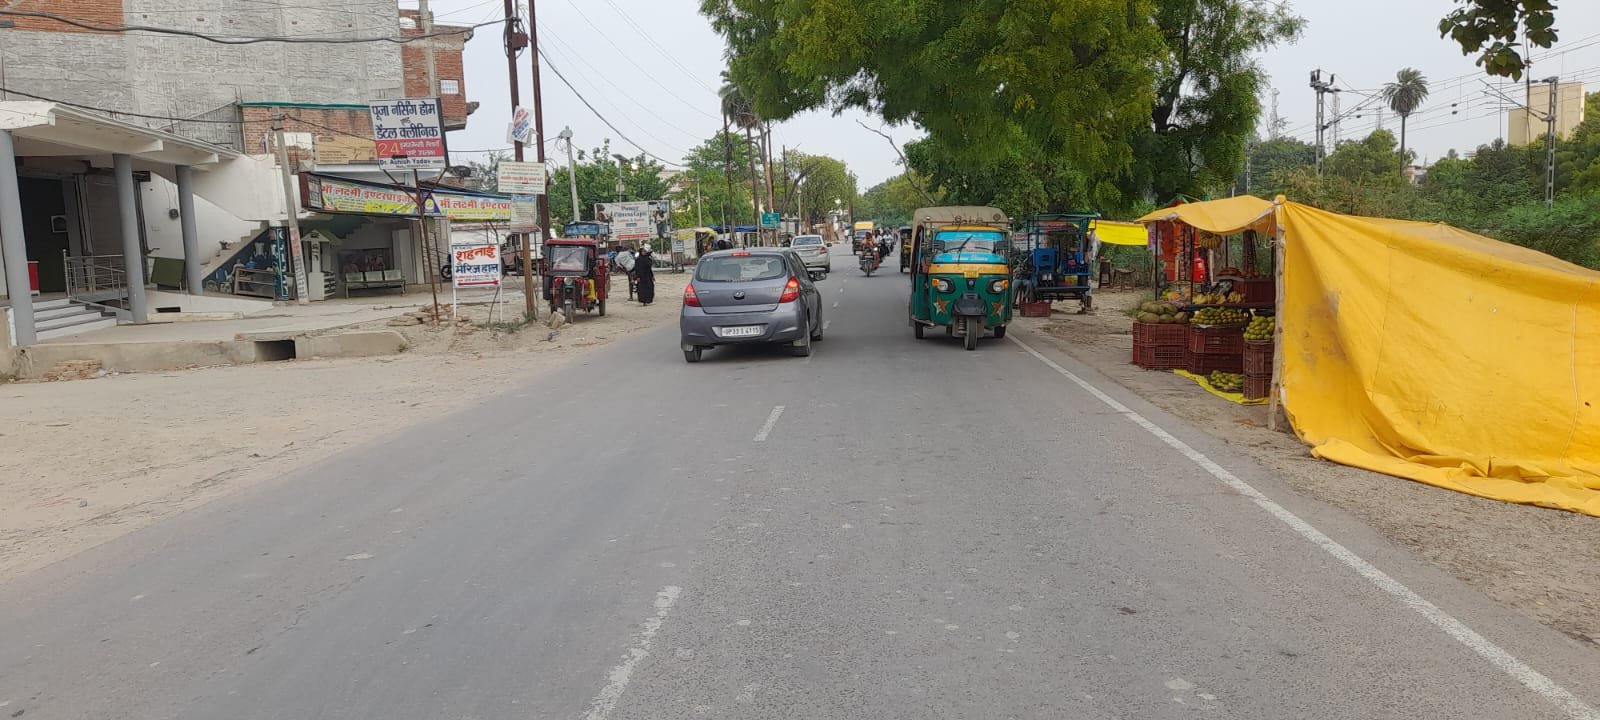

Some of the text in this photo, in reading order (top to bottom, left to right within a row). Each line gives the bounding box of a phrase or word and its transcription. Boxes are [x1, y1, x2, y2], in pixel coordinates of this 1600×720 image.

[371, 105, 389, 121] पूजा
[418, 101, 436, 116] होम
[375, 124, 397, 139] डेंटल
[378, 142, 400, 156] 24
[456, 245, 496, 262] शहनाई
